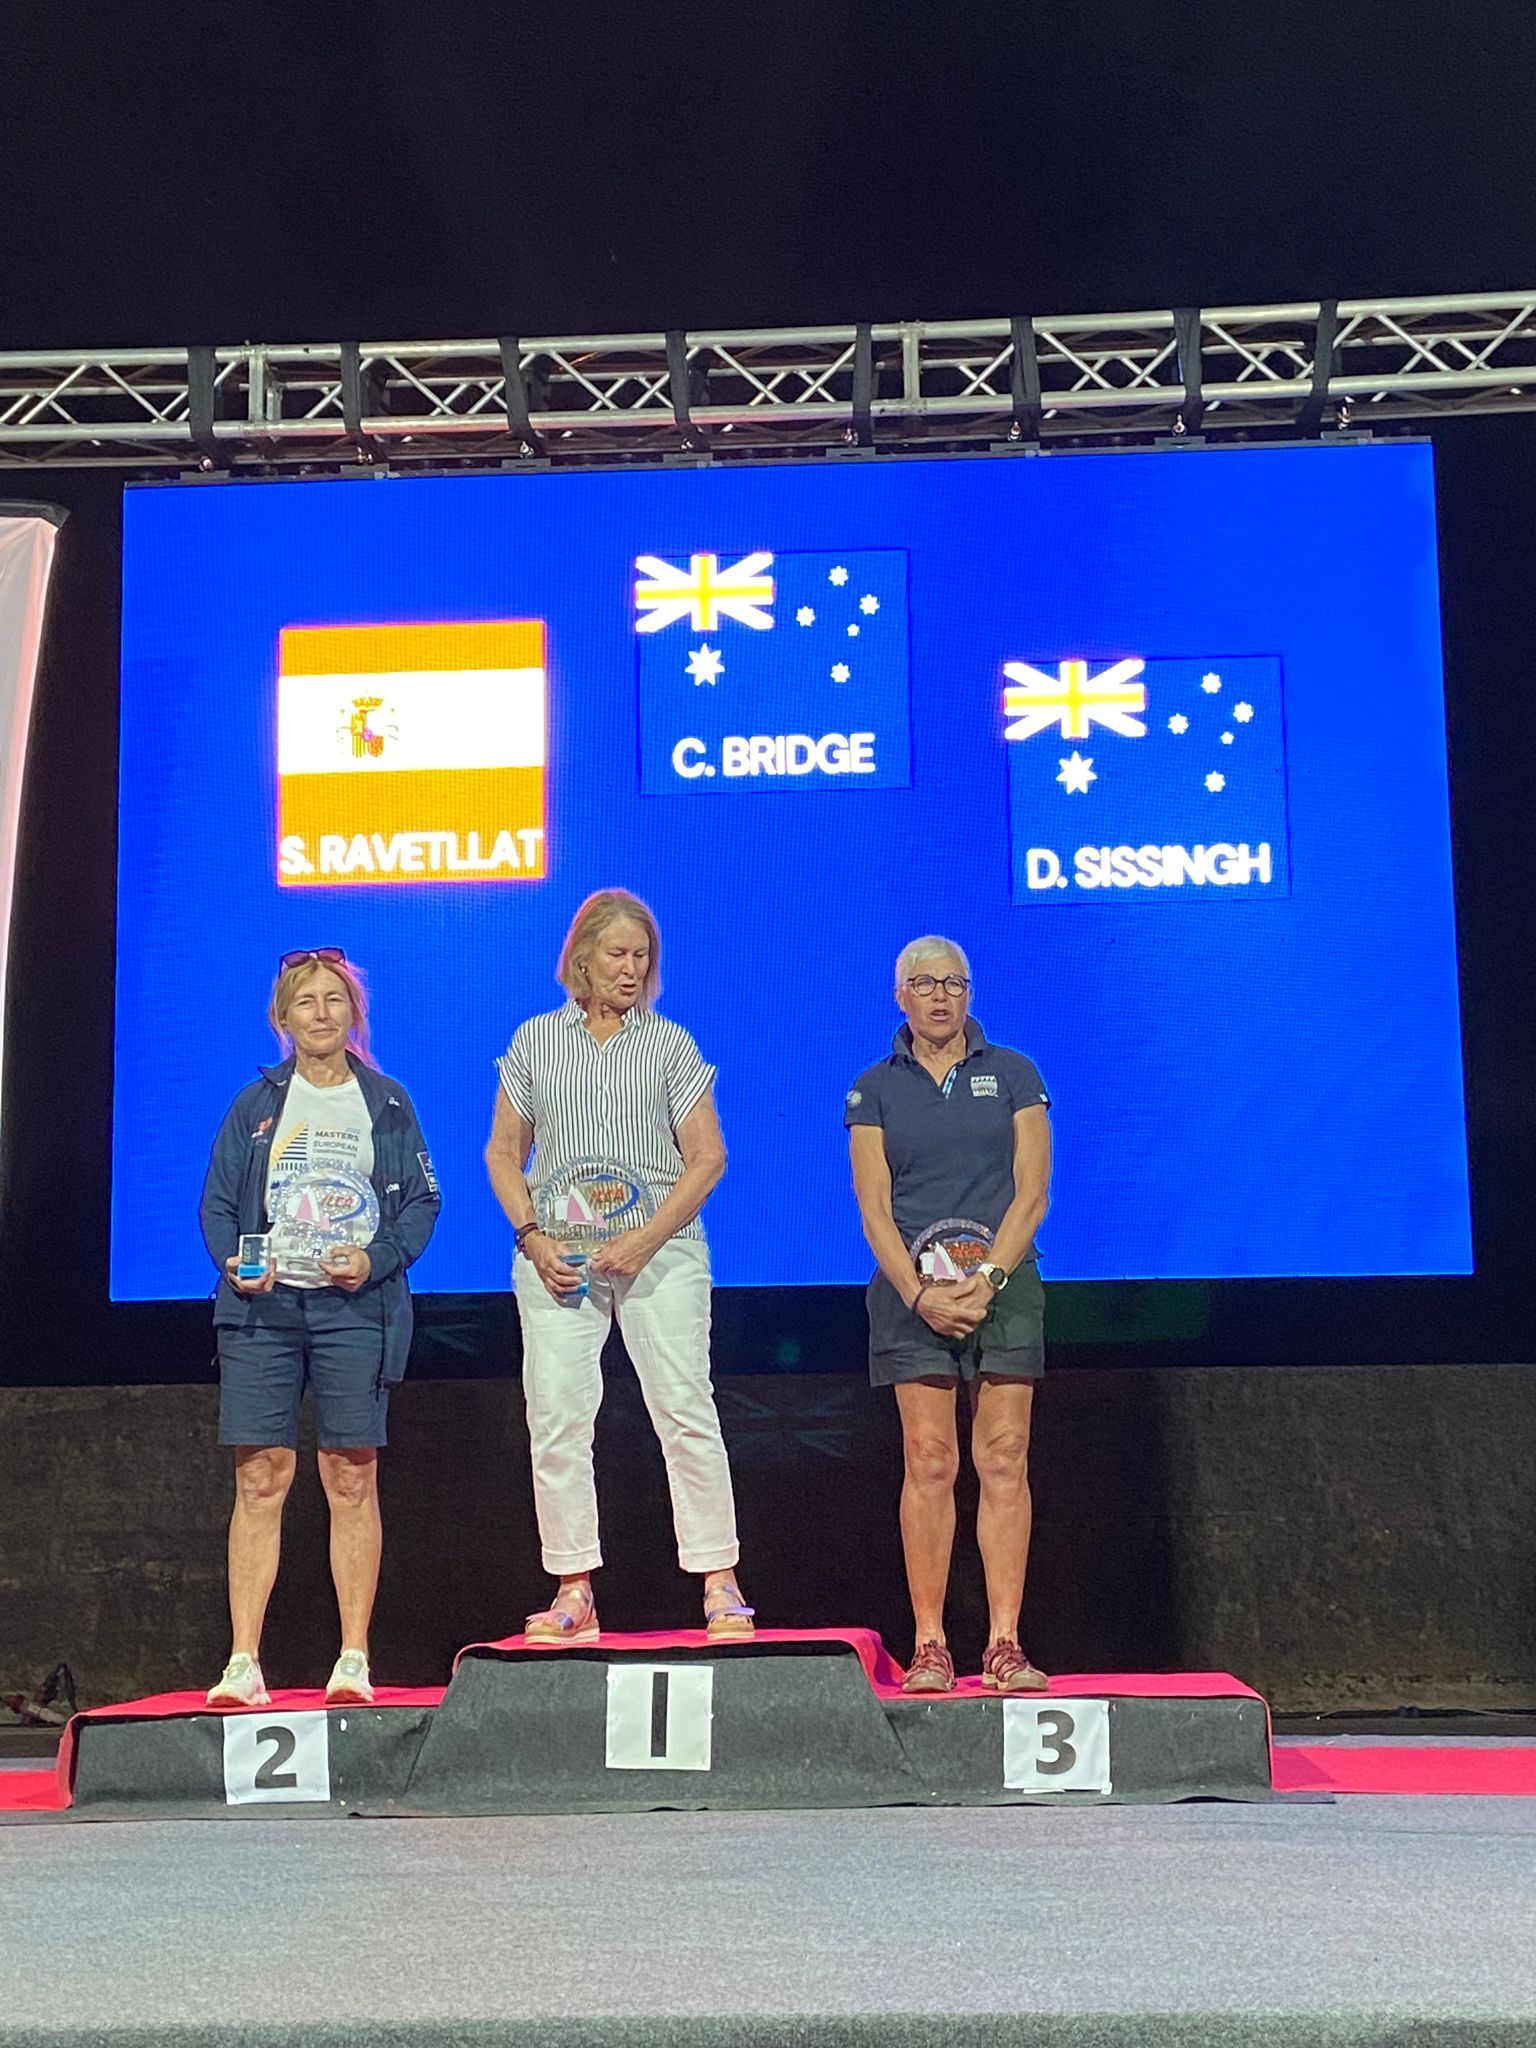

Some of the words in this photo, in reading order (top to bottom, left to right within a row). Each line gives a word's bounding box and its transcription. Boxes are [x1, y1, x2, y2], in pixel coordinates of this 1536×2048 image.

[672, 737, 716, 778] C.
[722, 733, 876, 777] BRIDGE
[279, 835, 315, 875] S.
[319, 828, 544, 874] RAVETLLAT
[1027, 848, 1068, 889] D.
[1074, 842, 1271, 888] SISSINGH
[313, 1140, 358, 1152] EUROPEAN
[314, 1130, 360, 1142] MASTERS
[254, 1726, 298, 1789] 2
[1036, 1709, 1076, 1774] 3
